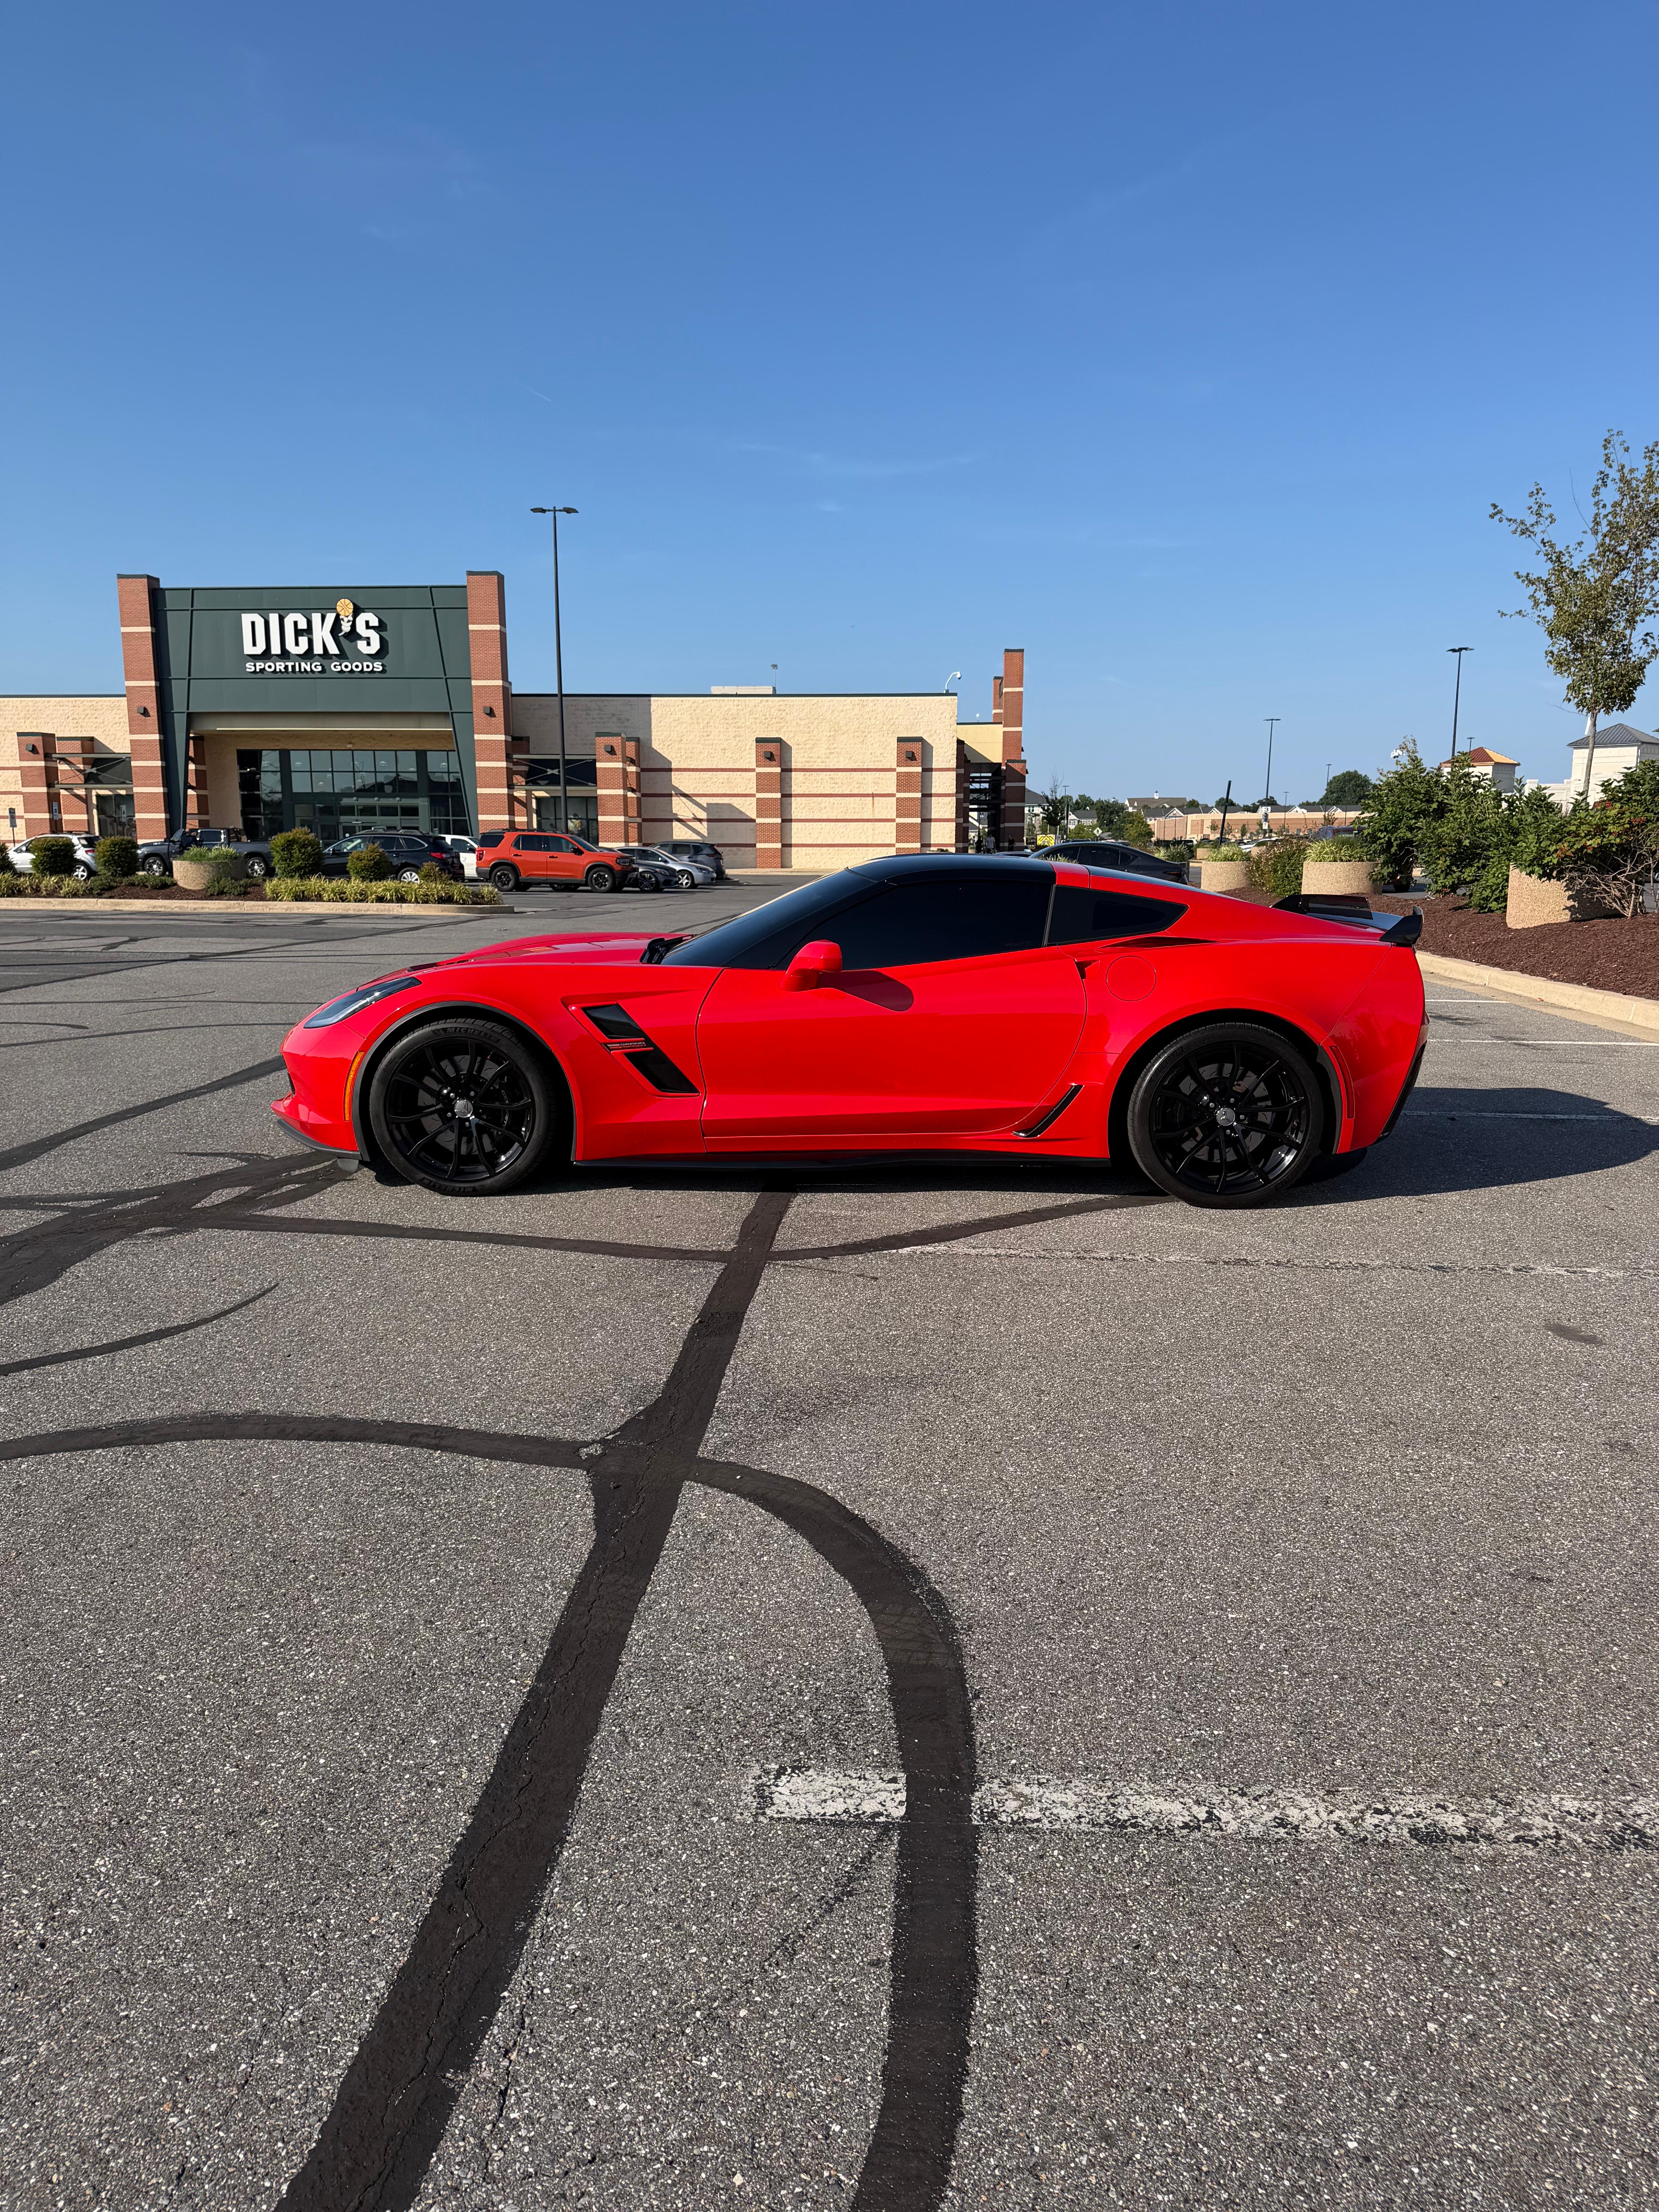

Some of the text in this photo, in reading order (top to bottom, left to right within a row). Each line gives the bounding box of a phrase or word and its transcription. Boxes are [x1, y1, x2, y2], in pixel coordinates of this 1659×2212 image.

[241, 612, 380, 654] DICK'S
[246, 662, 383, 672] SPORTING GOODS
